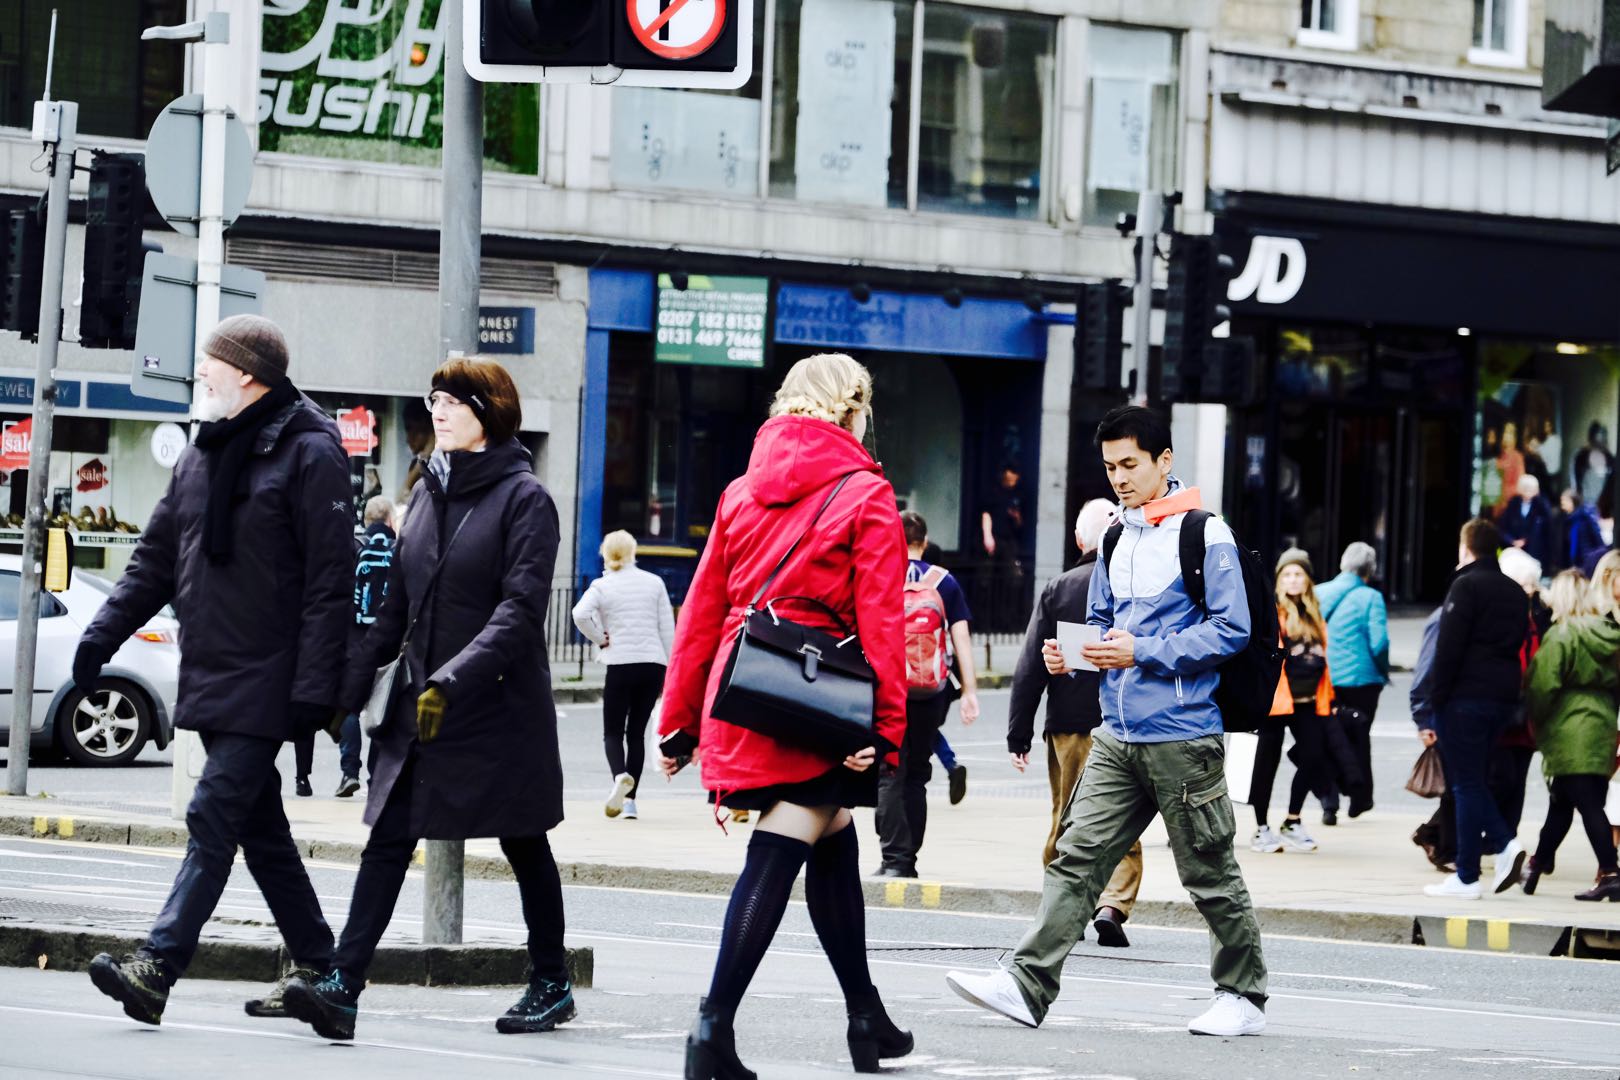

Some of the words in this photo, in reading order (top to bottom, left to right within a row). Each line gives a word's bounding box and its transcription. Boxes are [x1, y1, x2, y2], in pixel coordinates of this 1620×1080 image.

[258, 77, 432, 138] sushi
[1227, 235, 1306, 303] JD
[479, 316, 518, 330] RNEST
[479, 330, 515, 343] ONES
[657, 327, 692, 344] 0131
[80, 467, 102, 482] sale
